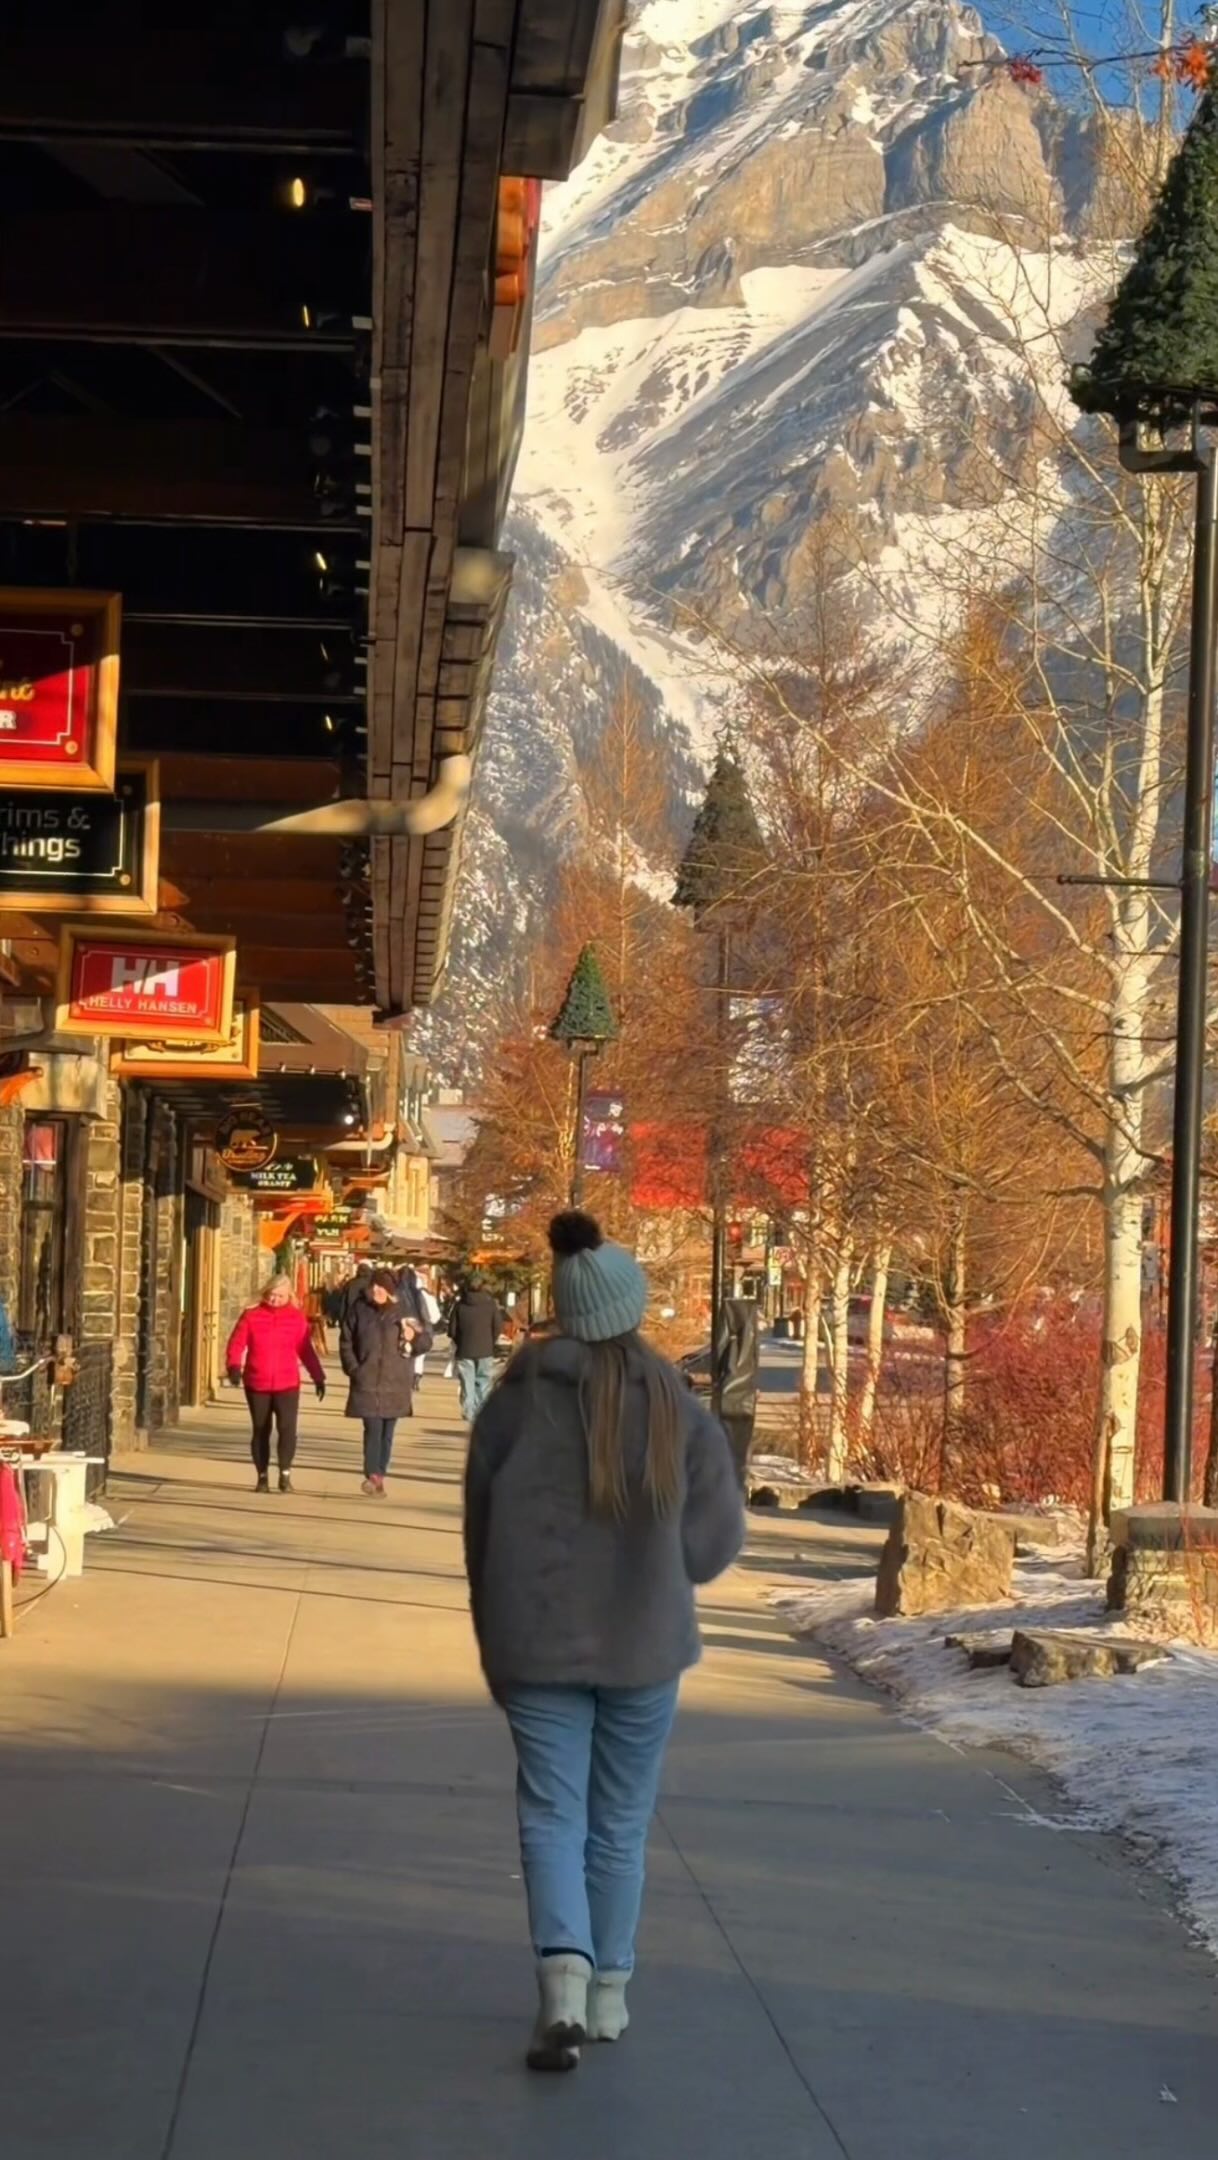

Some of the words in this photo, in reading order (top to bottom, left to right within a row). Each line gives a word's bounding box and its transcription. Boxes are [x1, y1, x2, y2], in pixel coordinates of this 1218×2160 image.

[67, 806, 91, 830] &
[1, 830, 81, 862] hings
[111, 957, 180, 997] HH
[89, 995, 132, 1009] HELLY
[138, 1000, 198, 1014] HANSEN
[277, 1172, 297, 1181] TEA
